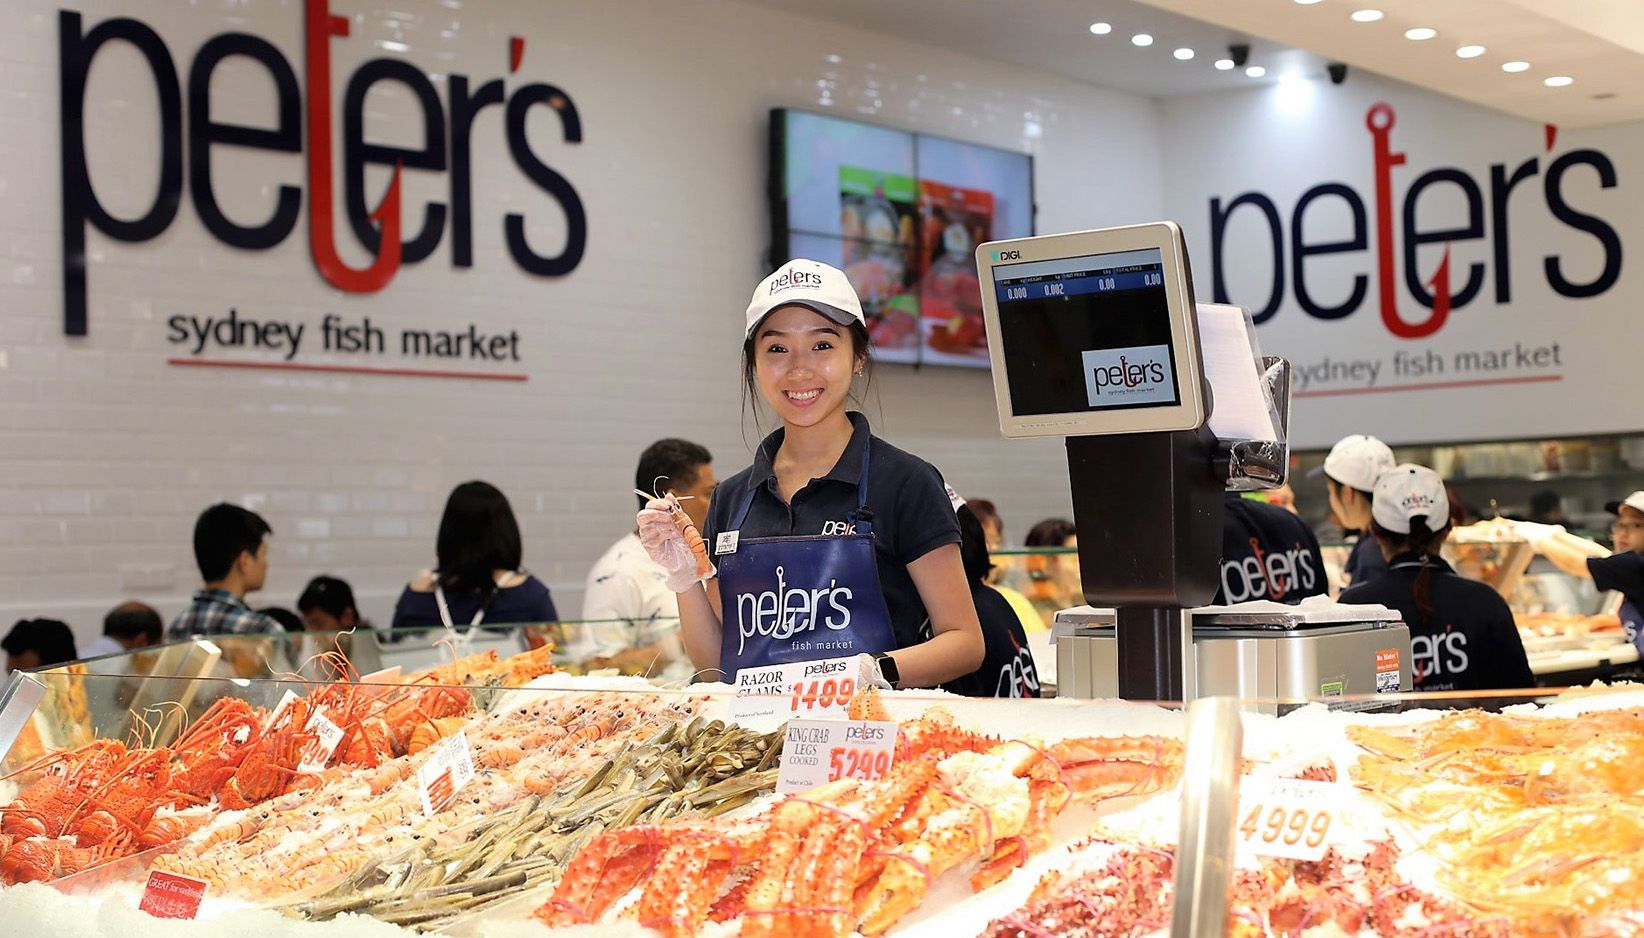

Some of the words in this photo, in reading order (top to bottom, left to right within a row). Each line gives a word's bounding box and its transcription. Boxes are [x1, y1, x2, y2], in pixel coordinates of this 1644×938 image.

[59, 0, 588, 337] peter's
[1208, 101, 1624, 340] peter's
[1000, 250, 1020, 261] DIGI
[1007, 287, 1027, 300] 0.000
[1044, 283, 1064, 296] 0.002
[1098, 278, 1115, 291] 0.00
[1144, 272, 1161, 286] 0.00
[167, 309, 305, 360] sydney
[321, 314, 385, 355] fish
[402, 325, 521, 361] market
[1393, 349, 1444, 377] fish
[1454, 343, 1563, 372] market
[1093, 355, 1165, 395] peter's
[1220, 537, 1316, 606] peter's
[737, 565, 853, 656] peter's
[792, 641, 812, 650] fish
[816, 640, 853, 650] market
[740, 671, 783, 687] RAZOR
[804, 661, 847, 678] peter's
[788, 727, 808, 743] KING
[808, 728, 830, 743] CRAB
[845, 722, 885, 742] peter's
[789, 755, 819, 766] COOKED
[794, 743, 818, 755] LEGS
[1239, 803, 1332, 849] 4999
